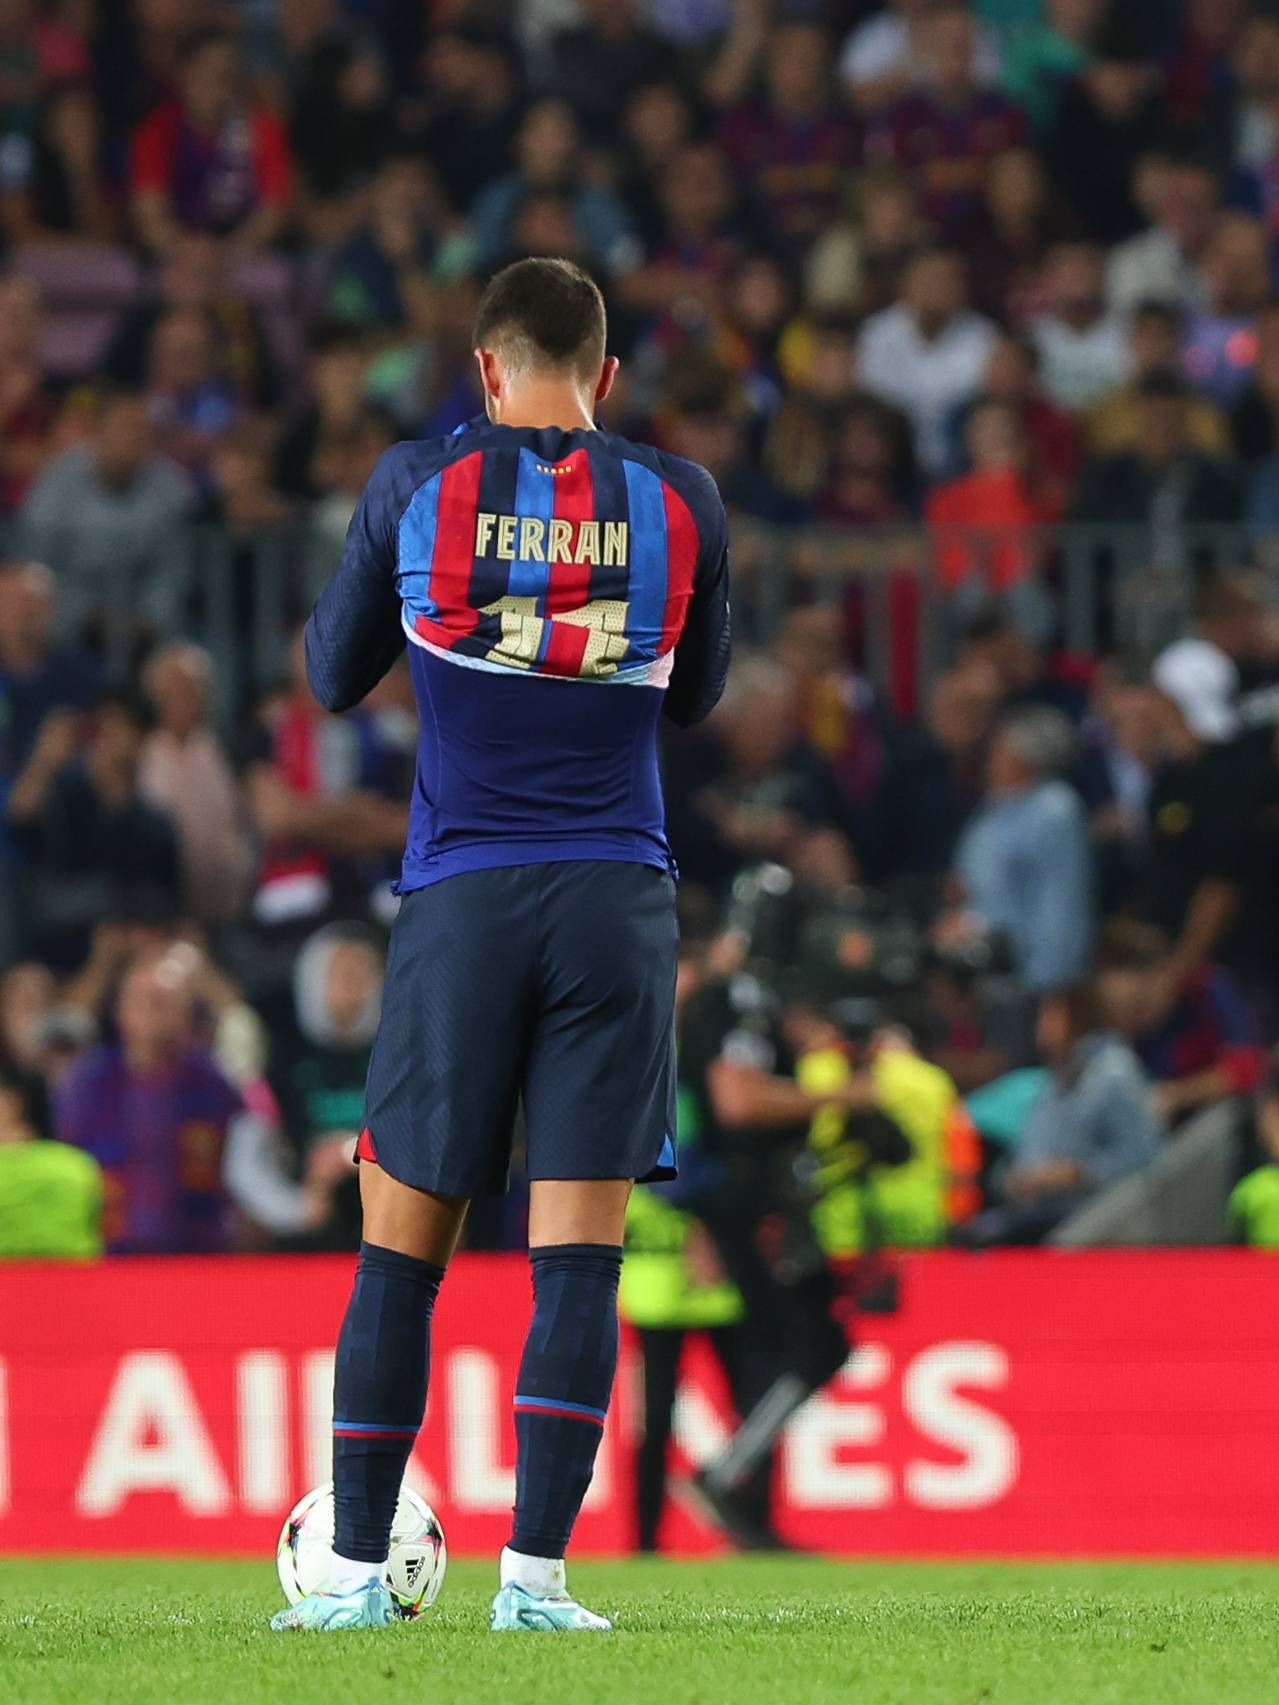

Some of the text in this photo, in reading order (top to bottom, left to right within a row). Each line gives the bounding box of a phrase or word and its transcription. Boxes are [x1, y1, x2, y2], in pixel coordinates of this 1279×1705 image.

[474, 512, 629, 567] FERRAN
[477, 595, 631, 677] 11
[408, 1556, 426, 1588] adidas
